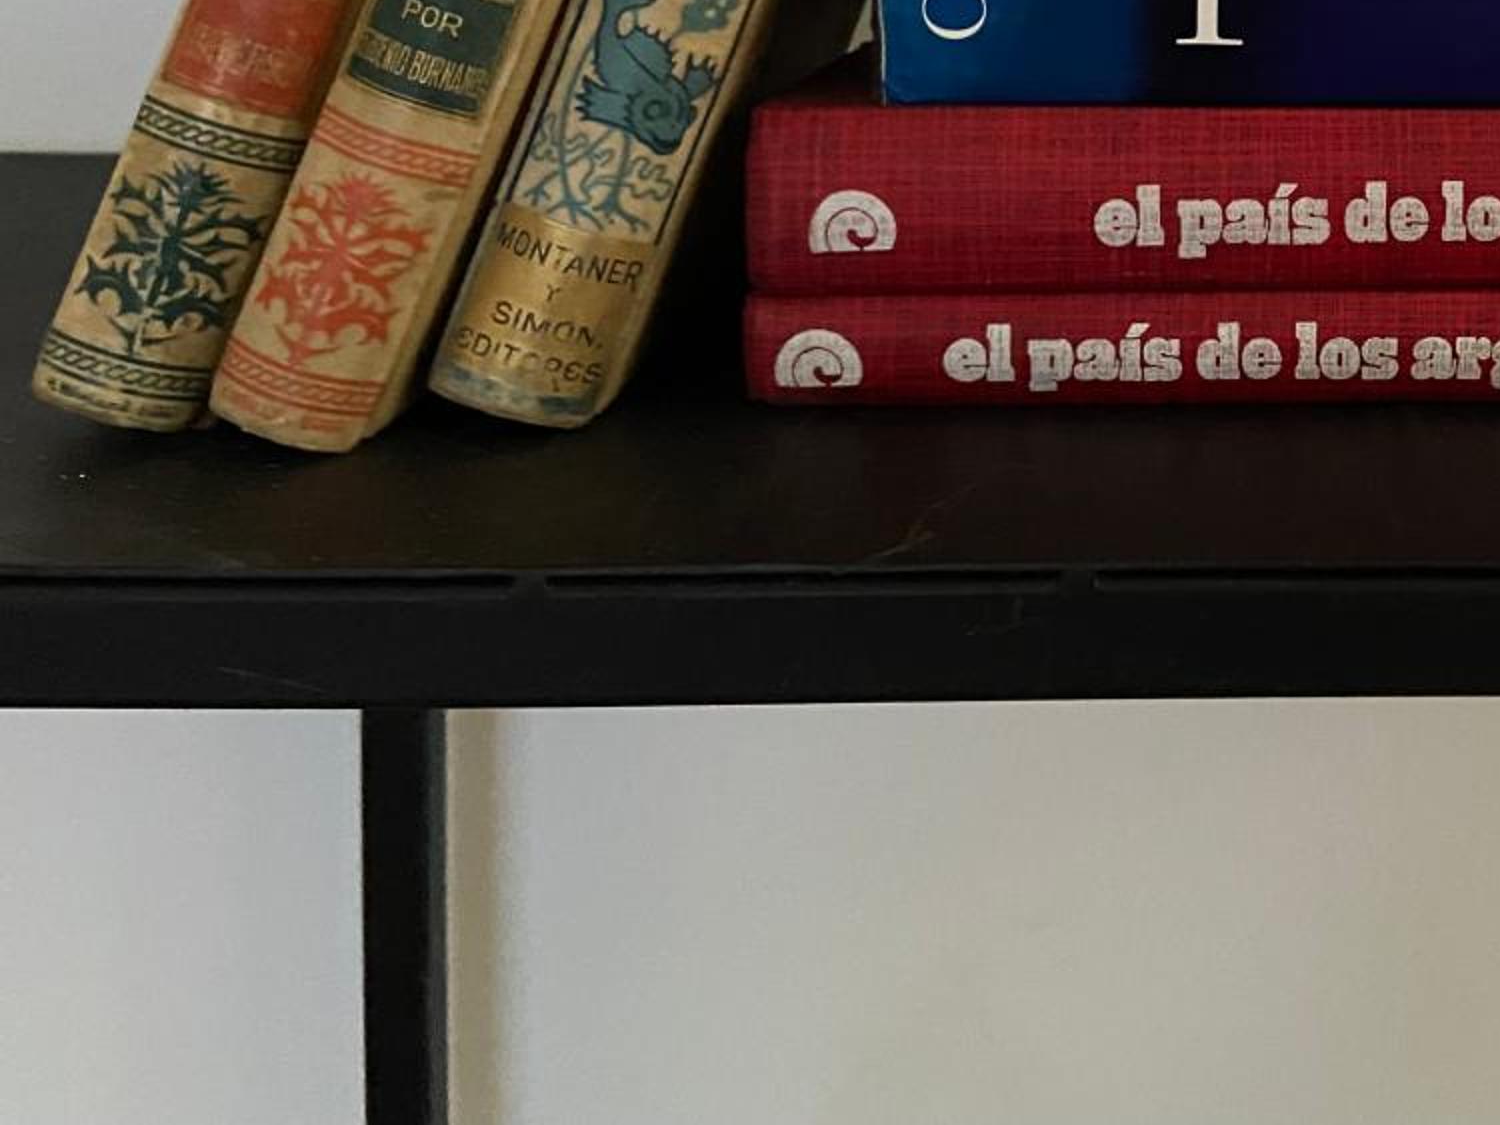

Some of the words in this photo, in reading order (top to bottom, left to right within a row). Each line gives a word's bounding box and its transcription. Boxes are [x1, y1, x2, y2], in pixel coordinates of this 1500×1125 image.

[1094, 184, 1165, 248] el
[1177, 183, 1330, 259] país
[1344, 181, 1430, 243] de
[498, 223, 644, 293] MONTANER
[545, 285, 561, 303] Y
[942, 323, 1016, 382] el
[1028, 322, 1183, 392] país
[1197, 321, 1283, 381] de
[1295, 321, 1400, 381] los
